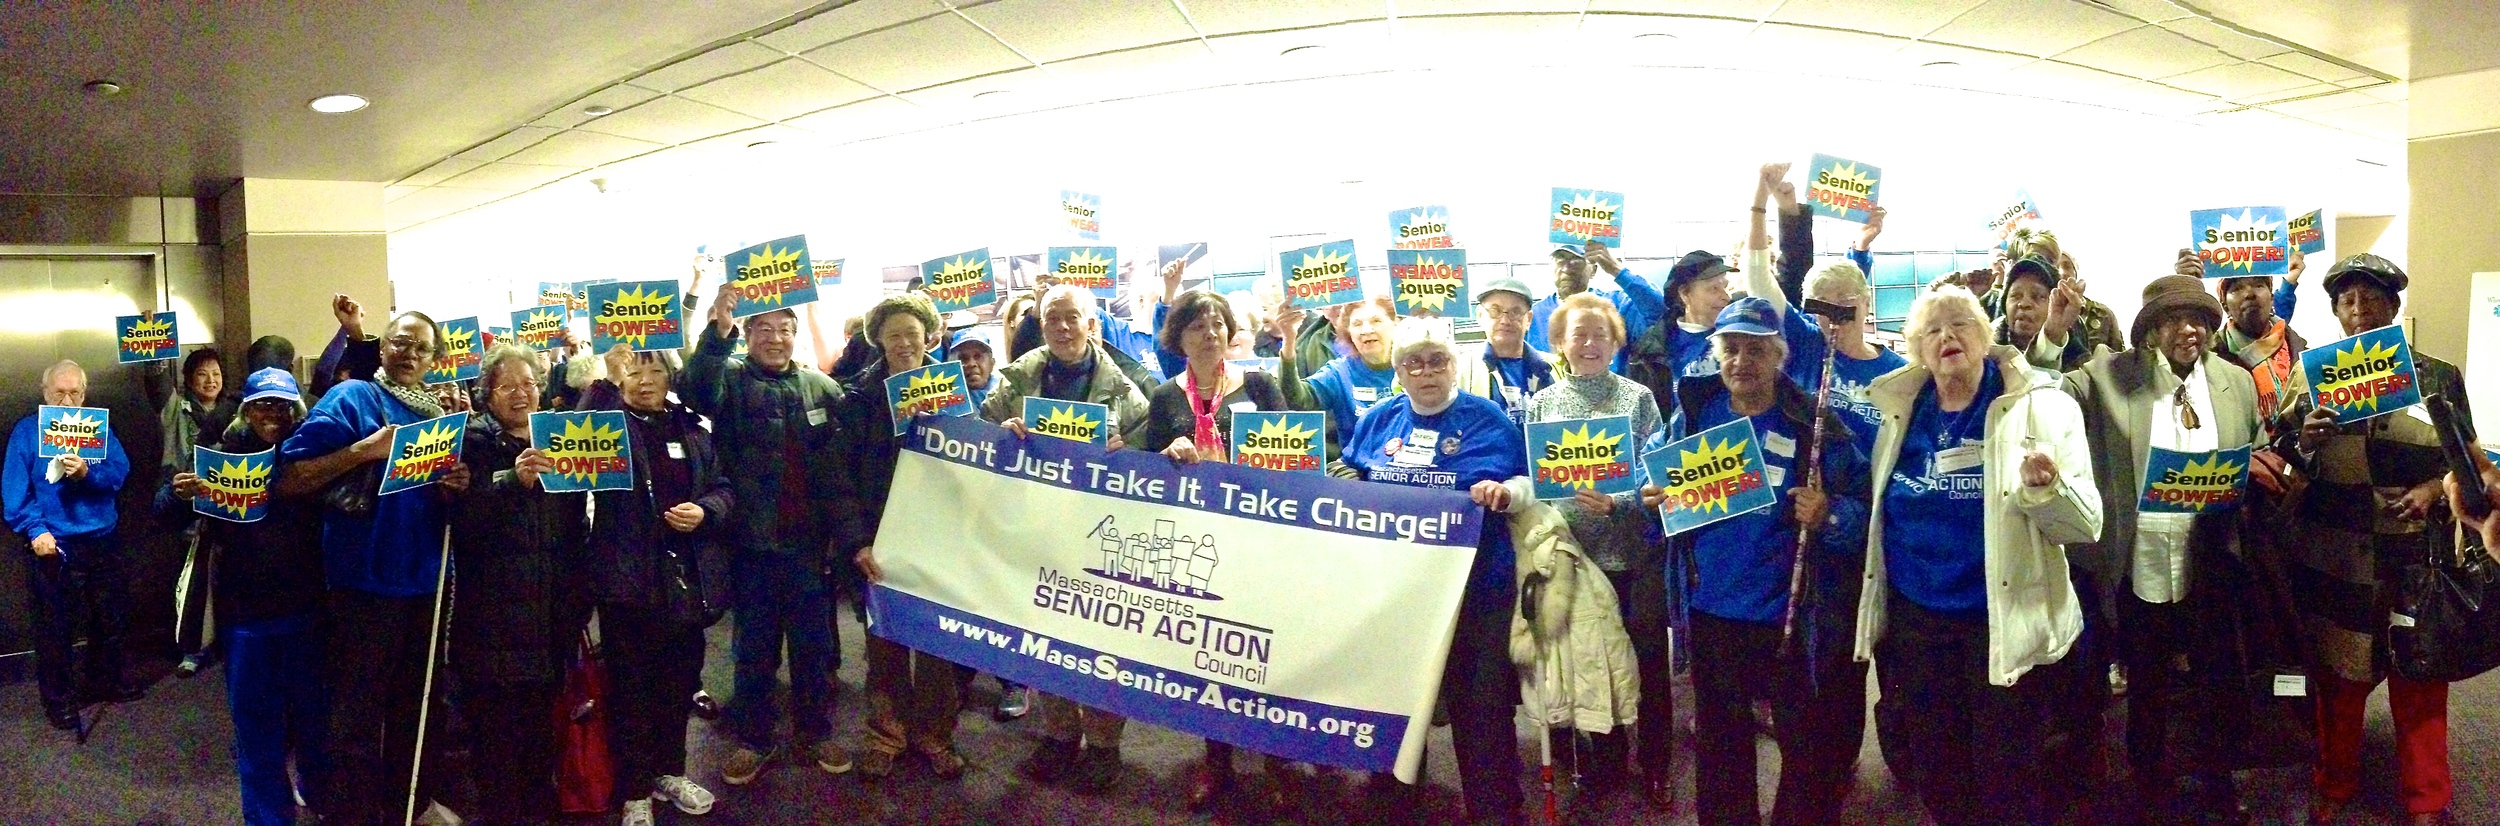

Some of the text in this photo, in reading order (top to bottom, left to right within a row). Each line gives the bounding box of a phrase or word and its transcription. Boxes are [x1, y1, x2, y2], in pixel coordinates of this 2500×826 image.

[1818, 171, 1872, 195] Senior
[1062, 200, 1095, 218] Senior
[1808, 187, 1877, 212] POWER!
[1560, 203, 1615, 220] Senior
[1988, 200, 2026, 231] Senior
[1400, 222, 1446, 238] Senior
[1552, 218, 1619, 237] POWER!
[2288, 215, 2315, 229] nior
[2205, 226, 2277, 244] Senior
[2198, 246, 2284, 264] POWER!
[737, 258, 799, 282] Senior
[933, 268, 984, 285] Senior
[1058, 262, 1109, 275] Senior
[1291, 260, 1348, 281] Senior
[733, 274, 811, 300] POWER!
[929, 280, 992, 301] POWER!
[1286, 276, 1358, 298] POWER!
[1401, 284, 1457, 298] Senior
[602, 301, 668, 318] Senior
[126, 326, 170, 338] Senior
[520, 319, 561, 332] Senior
[594, 319, 678, 337] POWER!
[121, 339, 176, 352] POWER!
[2322, 355, 2396, 385] Senior
[900, 381, 955, 402] Senior
[2317, 371, 2412, 407] POWER!
[897, 394, 966, 420] POWER!
[50, 421, 99, 434] Senior
[1037, 417, 1096, 438] Senior
[43, 434, 104, 449] POWER!
[402, 437, 455, 460] Senior
[549, 436, 620, 453] Senior
[1246, 432, 1311, 450] Senior
[1237, 452, 1320, 471] POWER!
[1545, 443, 1619, 461] Senior
[207, 470, 269, 489] Senior
[1370, 471, 1457, 485] SENIOR ACTION
[1537, 461, 1630, 483] POWER!
[1667, 453, 1745, 487] Senior
[2162, 472, 2239, 486] Senior
[916, 425, 1463, 542] "Don't Just Take It, Take Charge!"
[1664, 470, 1763, 514] POWER!
[1928, 474, 1983, 491] ACTION
[1038, 566, 1195, 618] Massachusetts
[1033, 584, 1274, 664] SENIOR ACTION
[1194, 650, 1267, 685] Council
[937, 613, 1376, 749] www.MassSeniorAction.org
